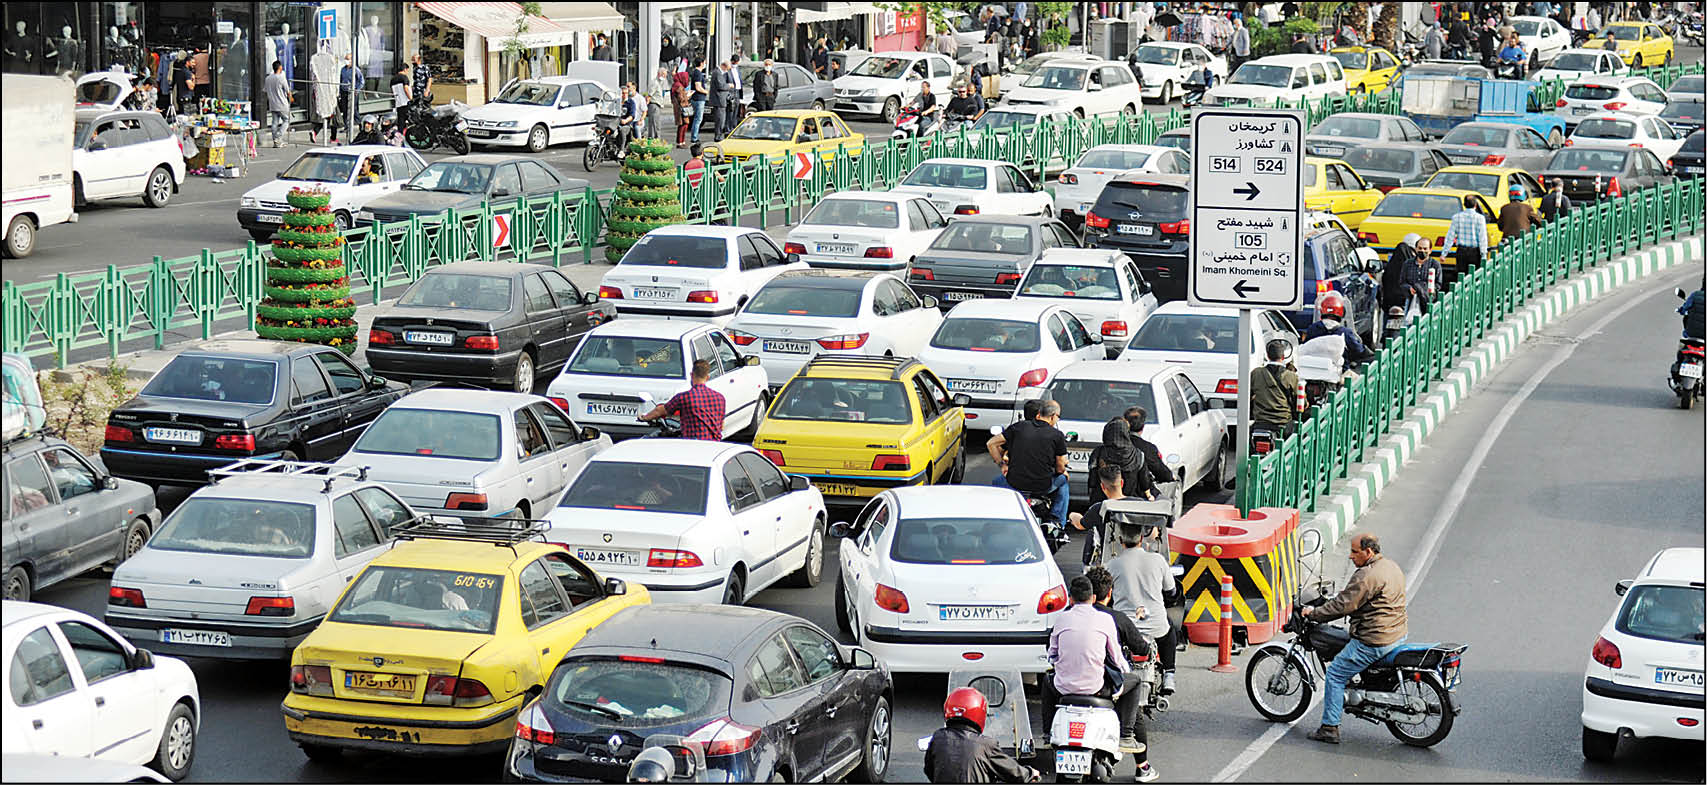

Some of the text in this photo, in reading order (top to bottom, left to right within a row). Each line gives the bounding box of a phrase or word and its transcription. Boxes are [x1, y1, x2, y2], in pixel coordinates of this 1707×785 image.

[1228, 121, 1277, 133] کریمخان
[1235, 139, 1275, 150] کشاورز
[1213, 158, 1283, 172] 514 524
[1217, 217, 1274, 231] شهید مفتح
[1239, 234, 1262, 247] 105
[1213, 252, 1246, 263] خمینی
[1249, 252, 1273, 265] امام
[1202, 265, 1289, 277] Imam Khomeini Sq.
[816, 483, 842, 493] ت۲۴۱
[583, 551, 638, 564] ۵۵ه۹۲۴ ۱۰
[946, 607, 1005, 619] ۷۷ن۸۷۲ ۱۰
[214, 634, 227, 644] ۶۵
[402, 679, 413, 690] ۱۱
[591, 756, 634, 767] SCALA
